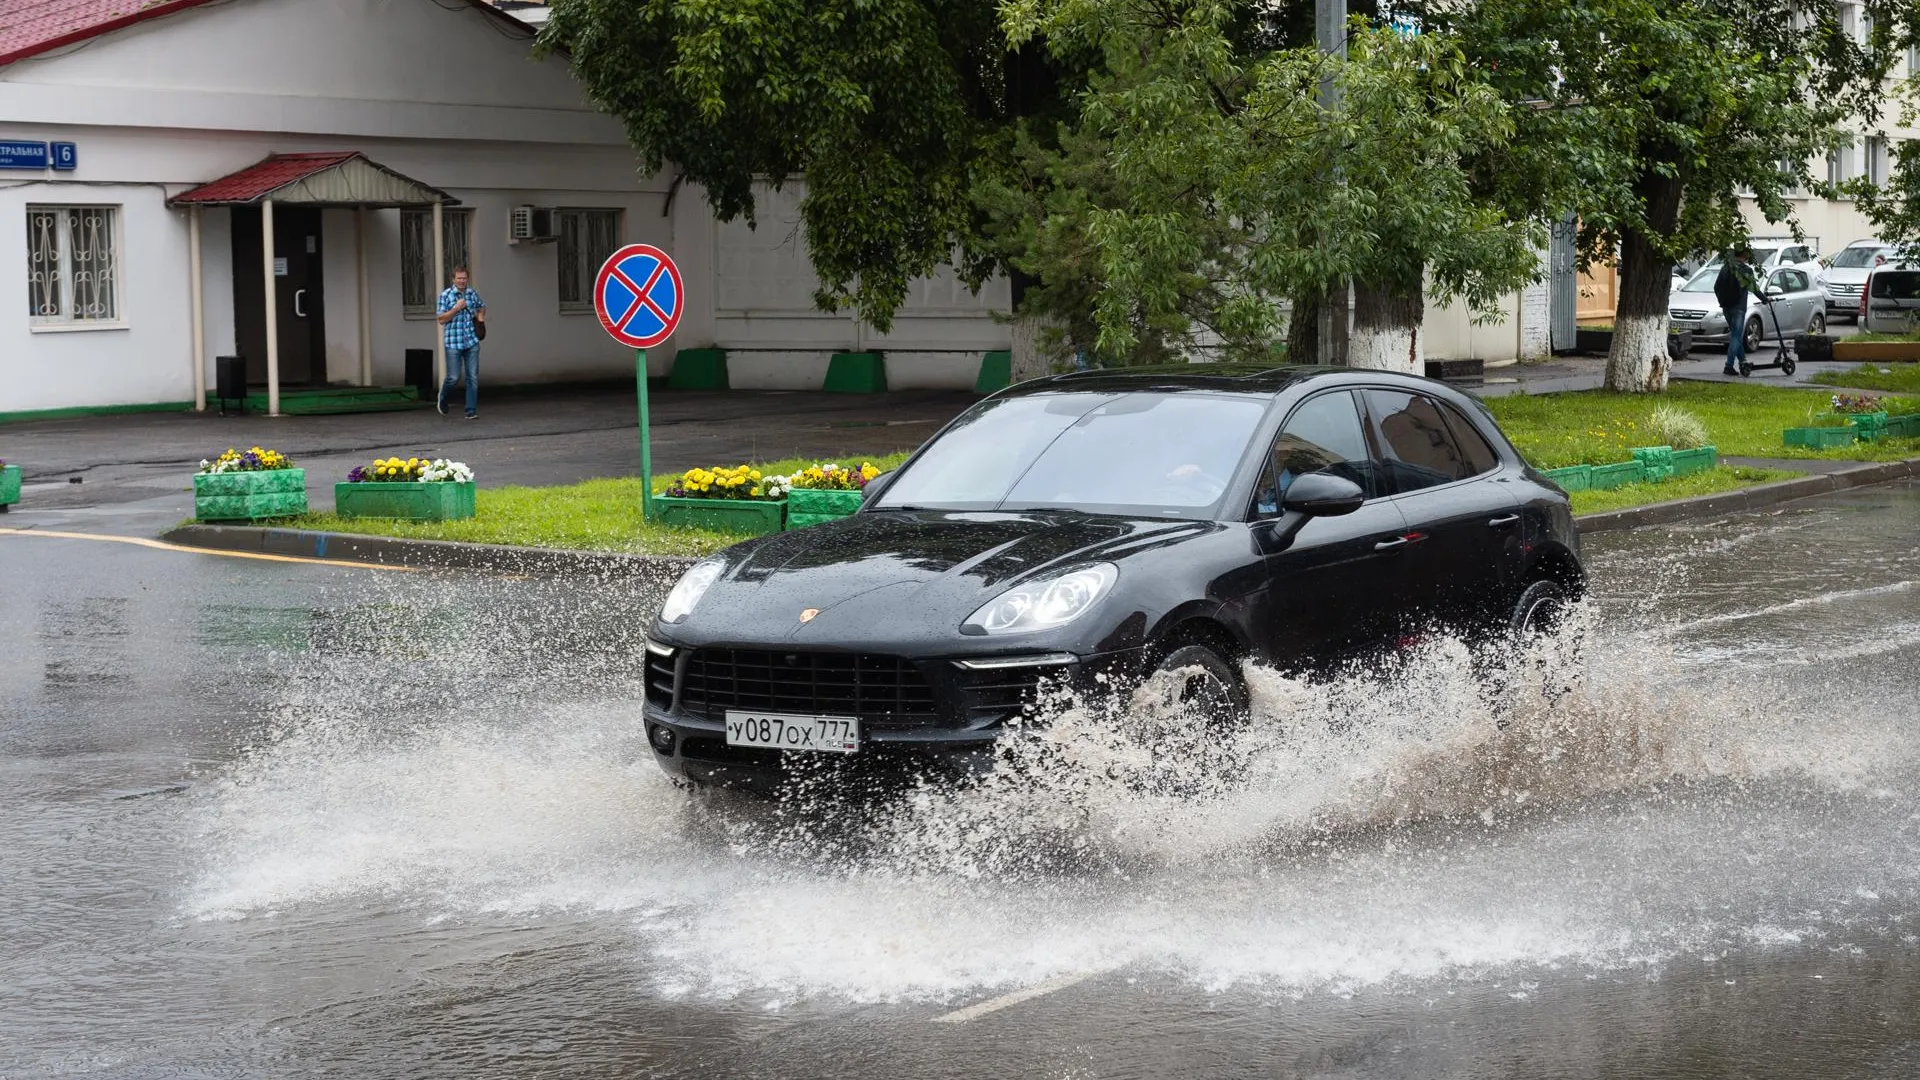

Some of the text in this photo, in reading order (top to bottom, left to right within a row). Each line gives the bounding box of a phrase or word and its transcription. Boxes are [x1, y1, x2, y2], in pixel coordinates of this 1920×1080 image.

[0, 146, 44, 156] ТРАЛЬНАЯ
[62, 146, 71, 161] 6
[817, 720, 850, 740] 777
